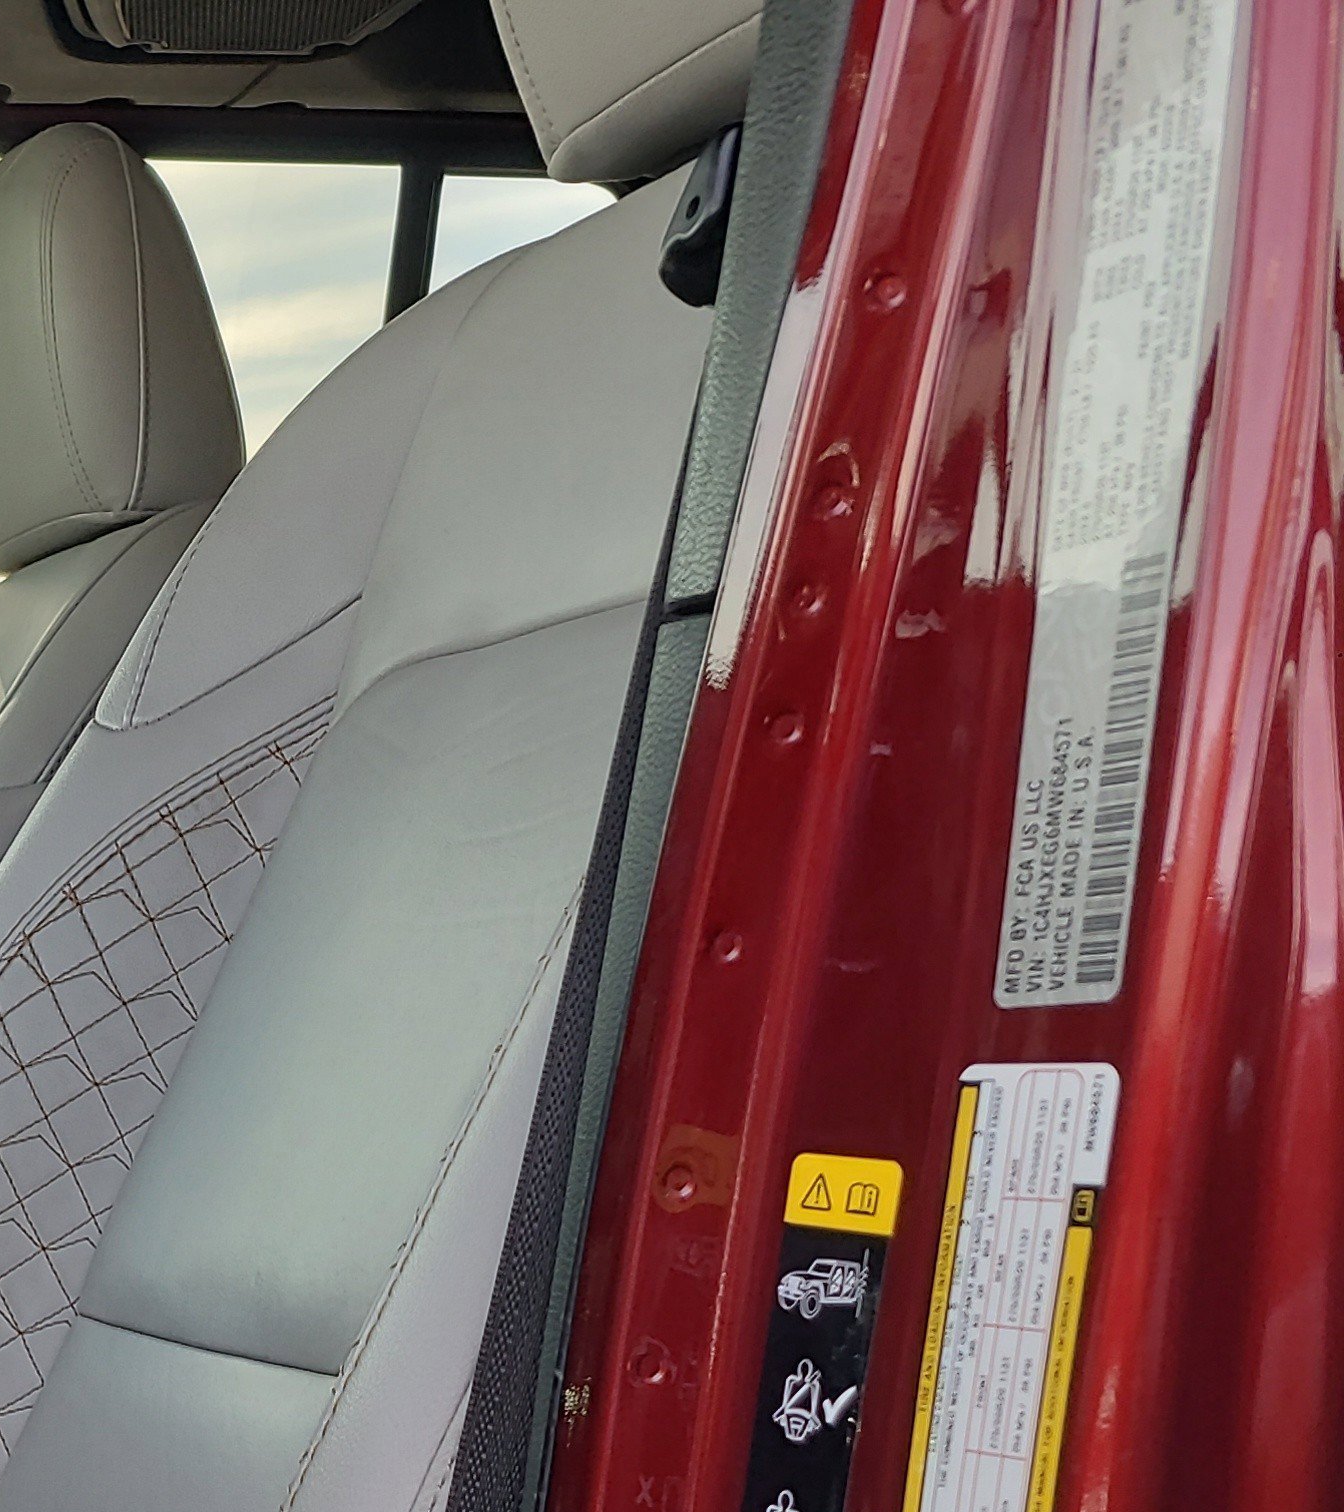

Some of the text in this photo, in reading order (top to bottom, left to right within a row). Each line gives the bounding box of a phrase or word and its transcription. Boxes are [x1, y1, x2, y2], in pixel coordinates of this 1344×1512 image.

[1025, 778, 1044, 816] LLC
[1021, 822, 1039, 851] US
[1015, 859, 1034, 897] FCA
[1060, 838, 1081, 898] MADE
[1049, 908, 1072, 991] VEHICLE
